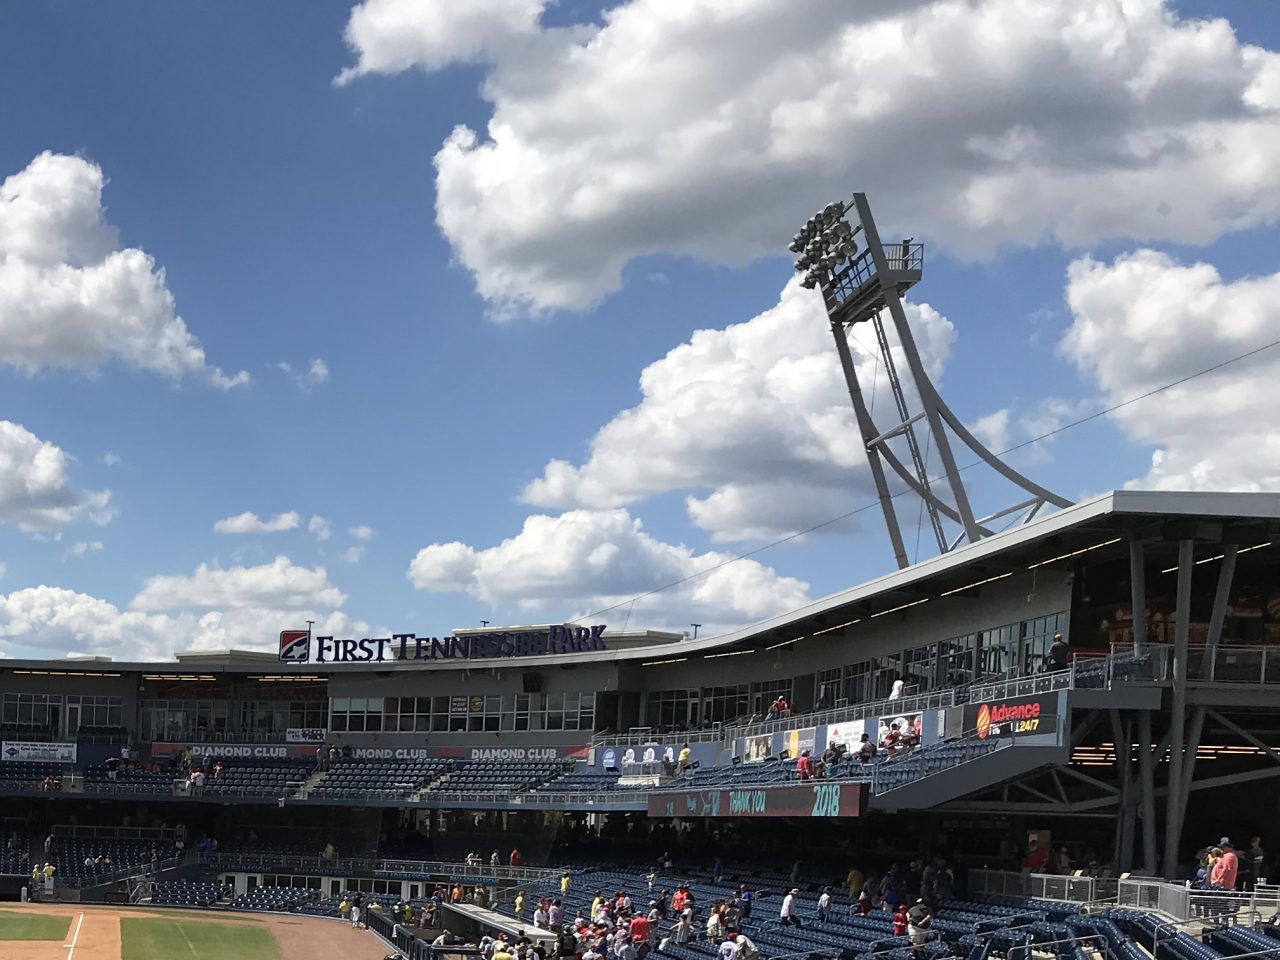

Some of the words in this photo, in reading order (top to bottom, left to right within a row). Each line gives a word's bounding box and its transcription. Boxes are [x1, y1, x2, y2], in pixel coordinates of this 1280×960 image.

[316, 636, 390, 661] FIRST
[392, 633, 548, 661] TENNESSEE
[548, 625, 607, 654] PARK
[990, 703, 1040, 722] Advance
[1020, 719, 1039, 732] 24/7
[192, 746, 251, 756] DIAMOND
[254, 747, 287, 757] CLUB
[395, 749, 427, 759] CLUB
[471, 749, 522, 759] DIAMOND
[527, 749, 557, 759] CLUB
[729, 791, 750, 815] THANK
[751, 790, 766, 815] YOU
[811, 785, 840, 816] 2018
